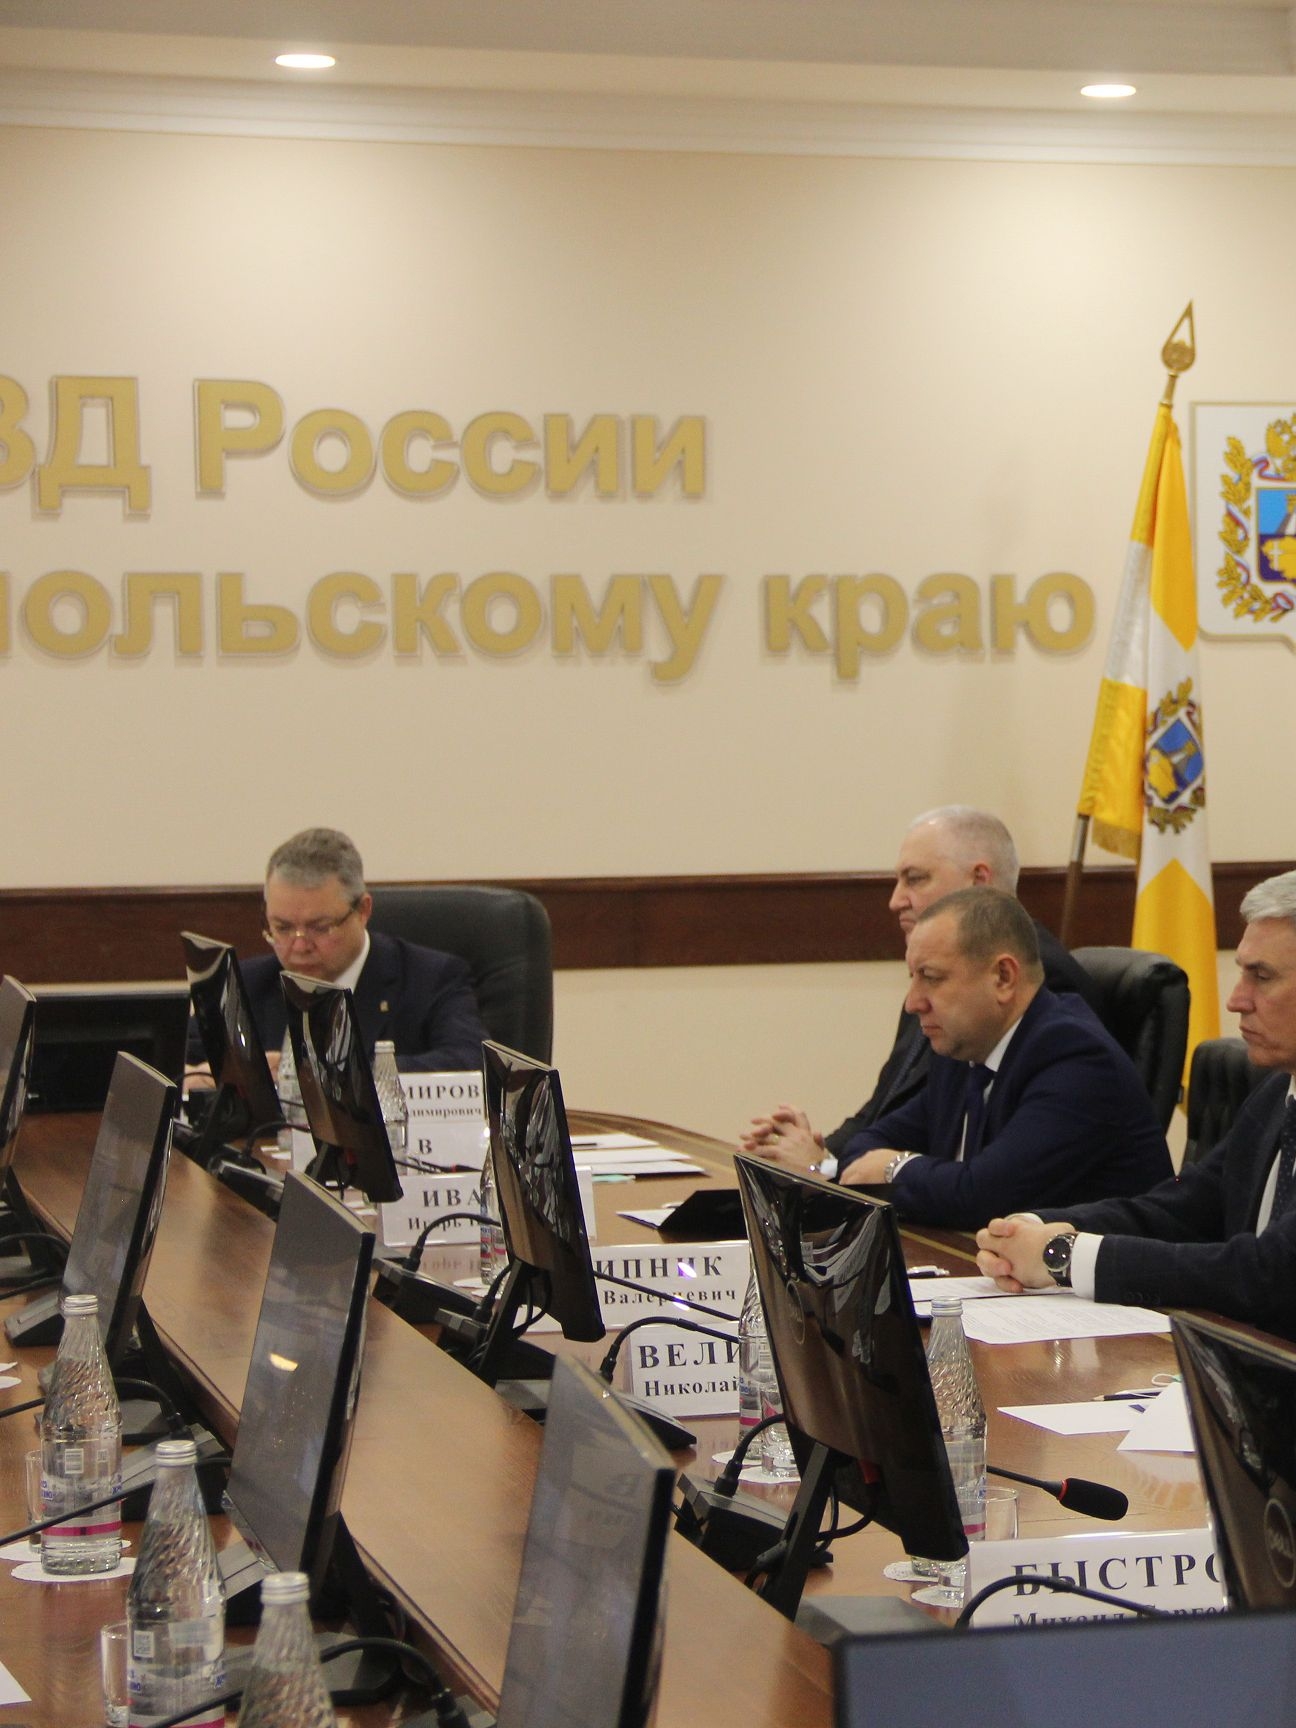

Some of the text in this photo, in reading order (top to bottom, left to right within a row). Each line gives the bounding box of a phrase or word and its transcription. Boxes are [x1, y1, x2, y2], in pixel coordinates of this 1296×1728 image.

[193, 377, 706, 498] России
[0, 570, 1095, 684] ольскому краю
[603, 1289, 737, 1307] Валеревич
